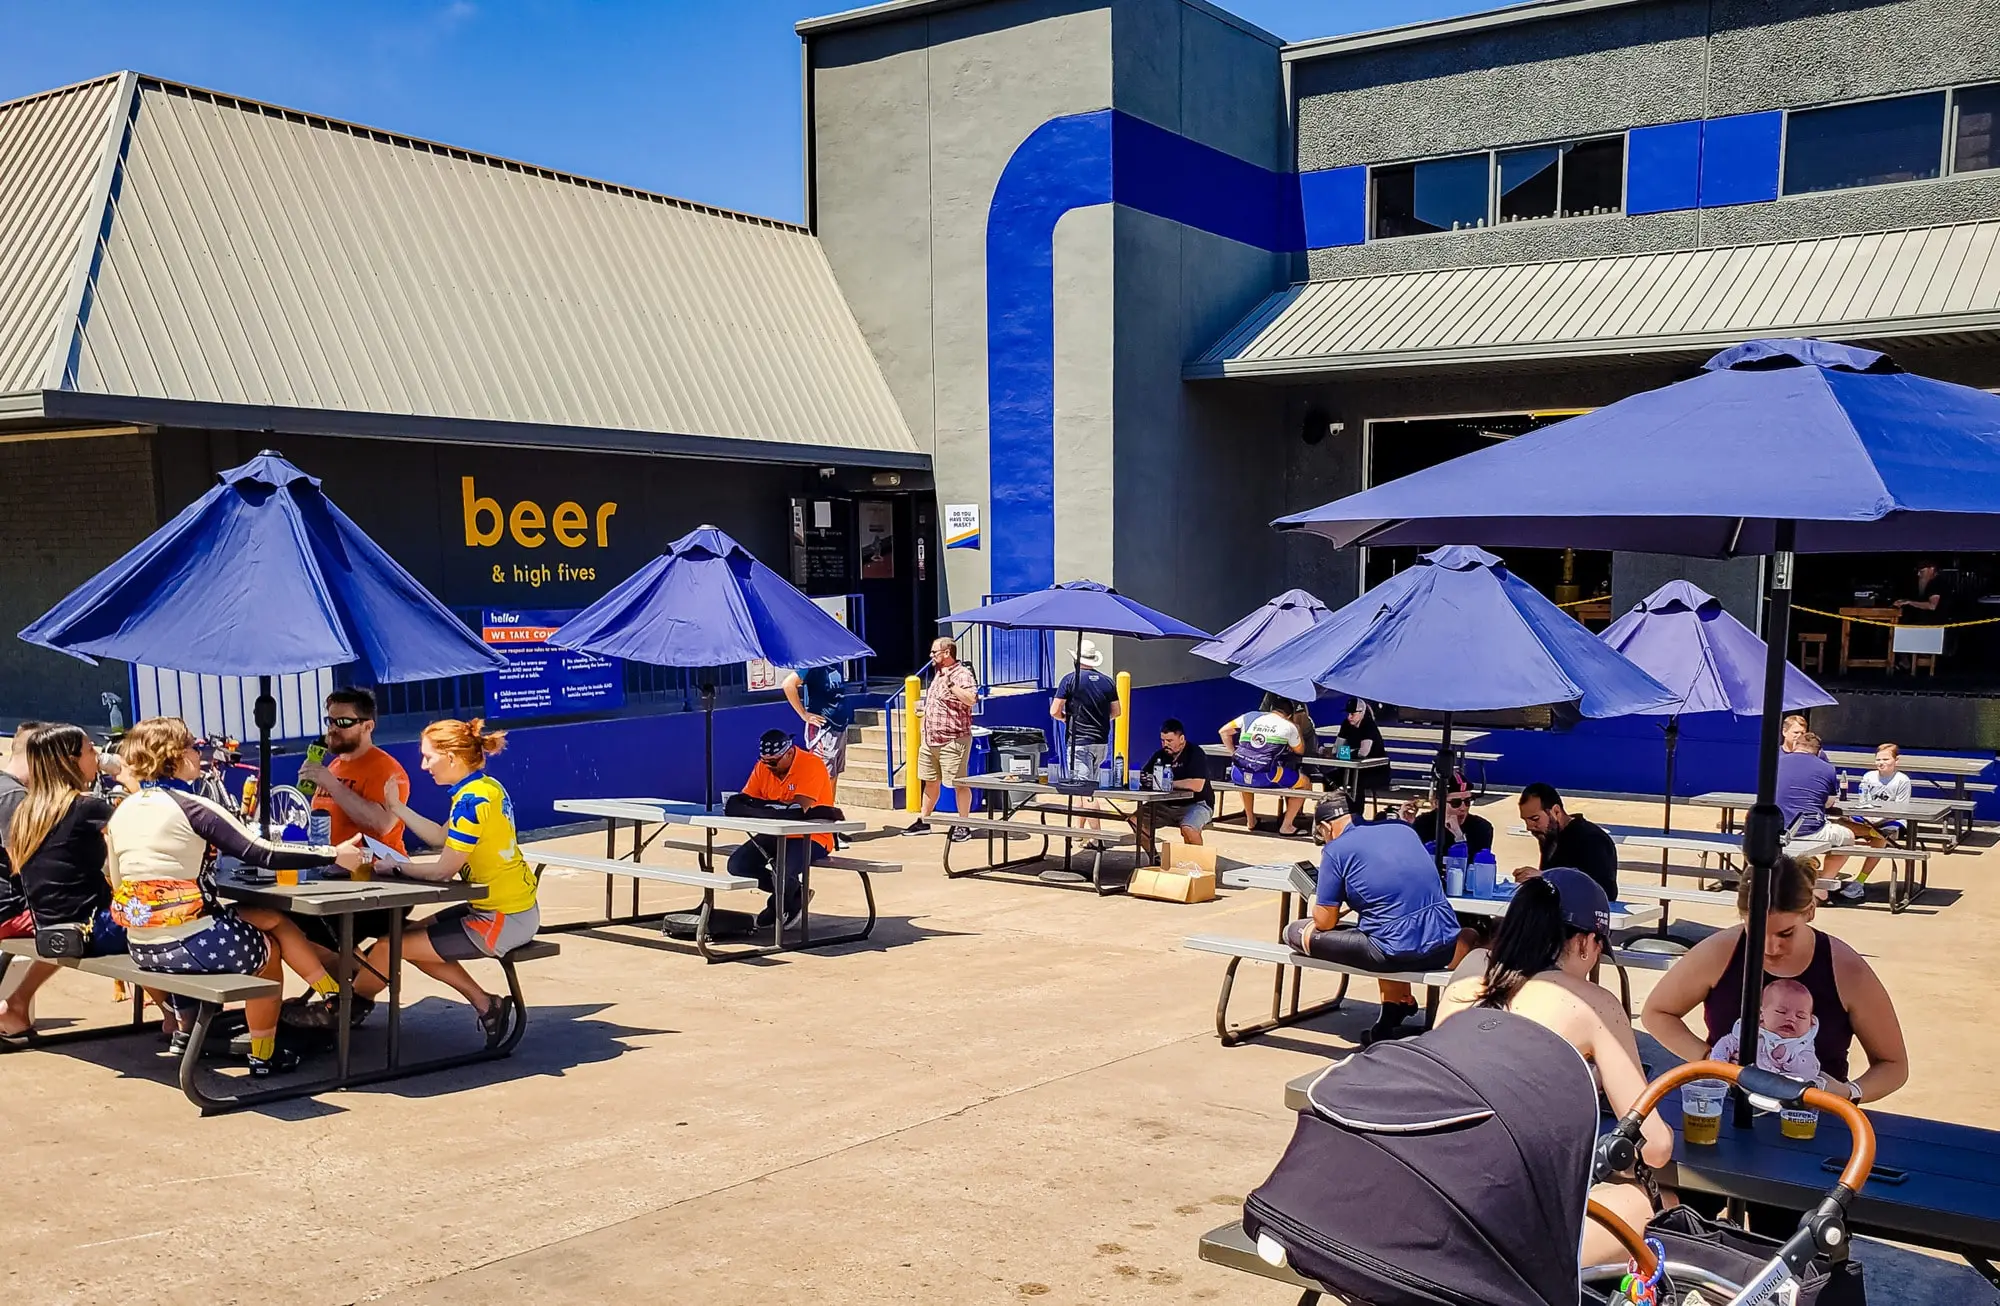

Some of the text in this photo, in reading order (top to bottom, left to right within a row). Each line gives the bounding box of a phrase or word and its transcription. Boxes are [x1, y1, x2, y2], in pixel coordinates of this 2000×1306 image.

[462, 476, 617, 548] beer
[492, 563, 596, 587] & high fives
[491, 613, 520, 623] hello!
[491, 631, 505, 640] WE
[509, 631, 529, 639] TAKE
[1341, 747, 1349, 755] 54
[1746, 1269, 1783, 1306] kingbird
